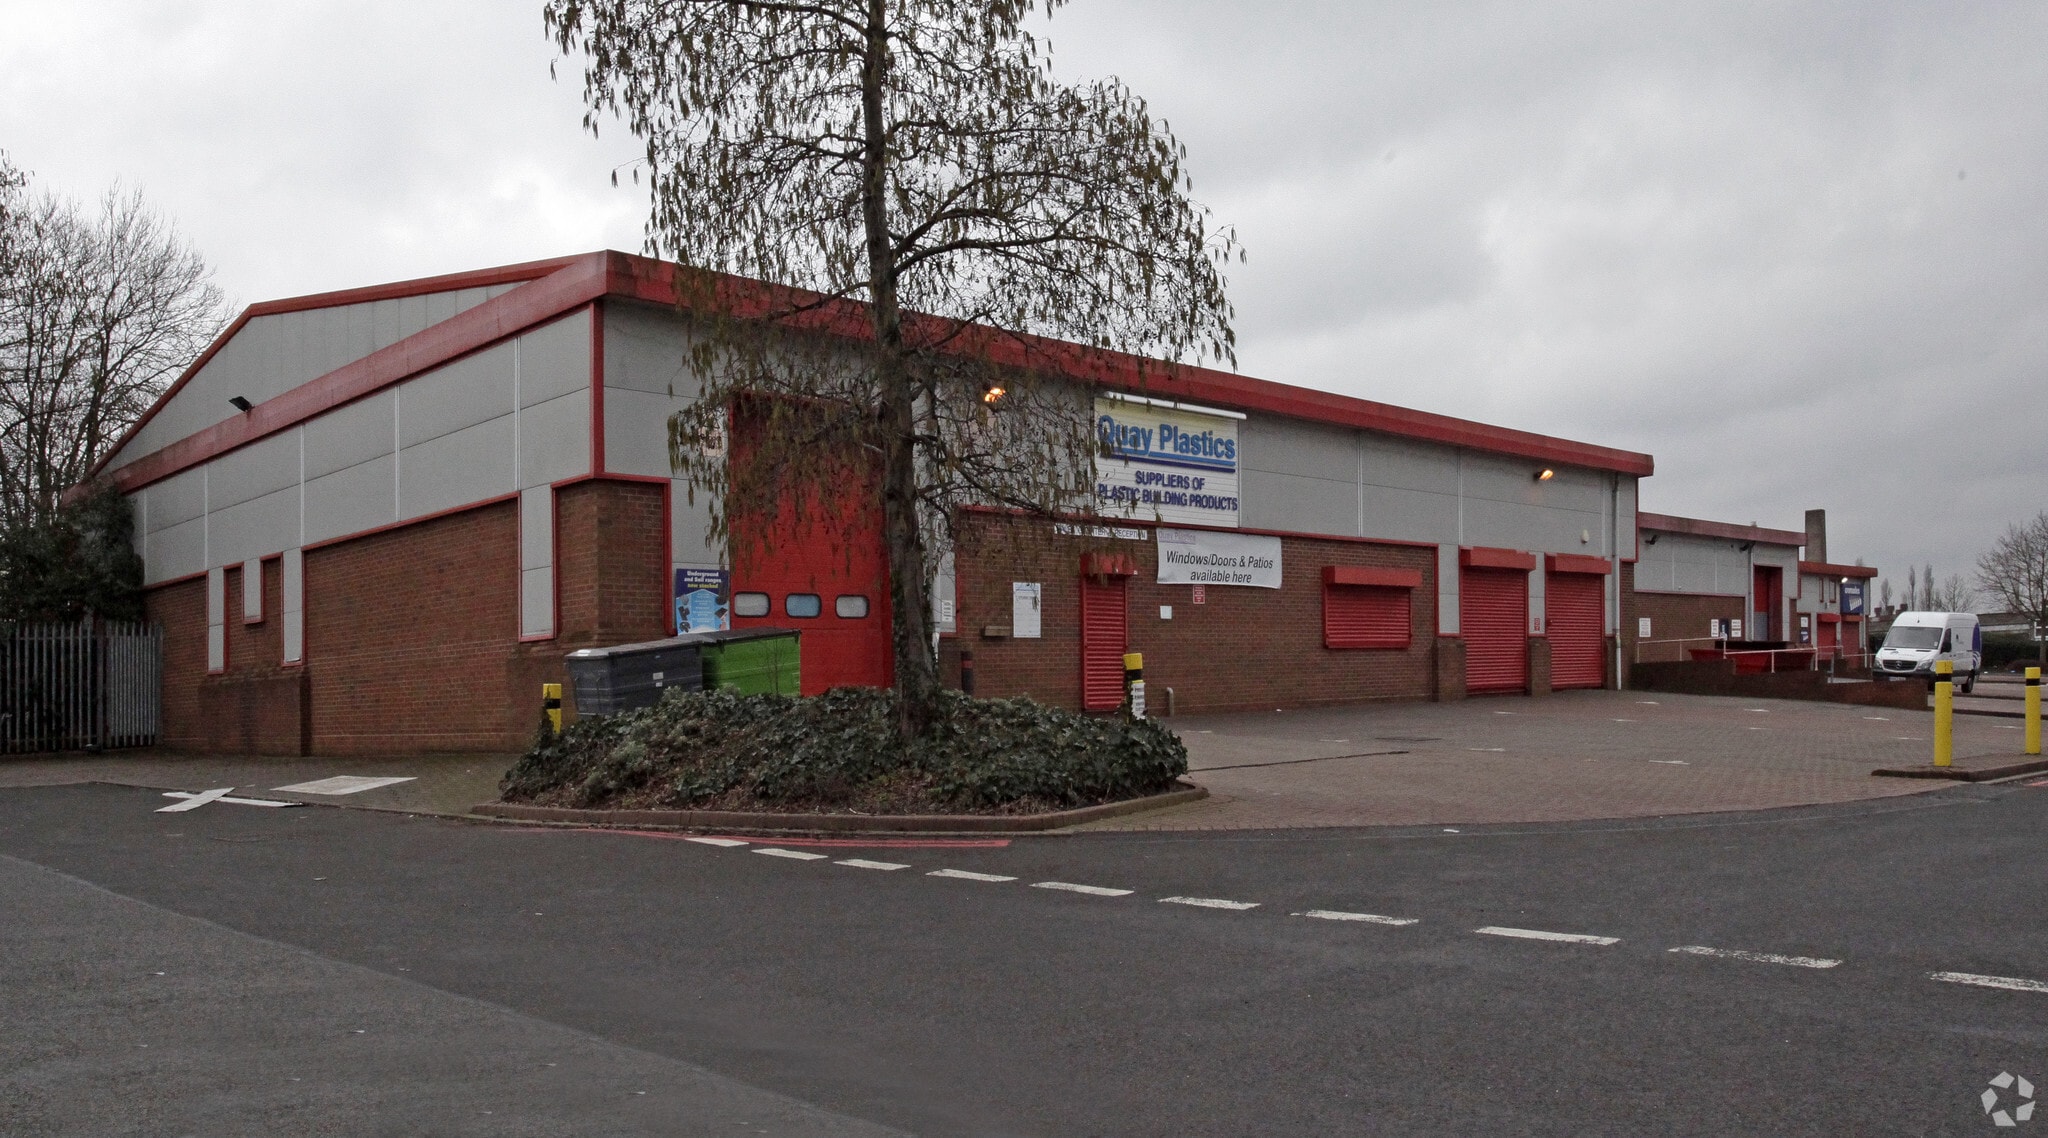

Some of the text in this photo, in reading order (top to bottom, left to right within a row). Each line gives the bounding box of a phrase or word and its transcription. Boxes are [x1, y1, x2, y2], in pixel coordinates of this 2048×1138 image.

[1098, 415, 1235, 459] Quay Plastics
[1135, 470, 1205, 490] SUPPLIERS OF
[1098, 483, 1238, 511] PLASTIC BUILDING PRODUCTS
[1114, 528, 1146, 539] RECEPTIN
[1166, 550, 1274, 569] Windows/Doors & Patios
[1190, 569, 1252, 583] available here
